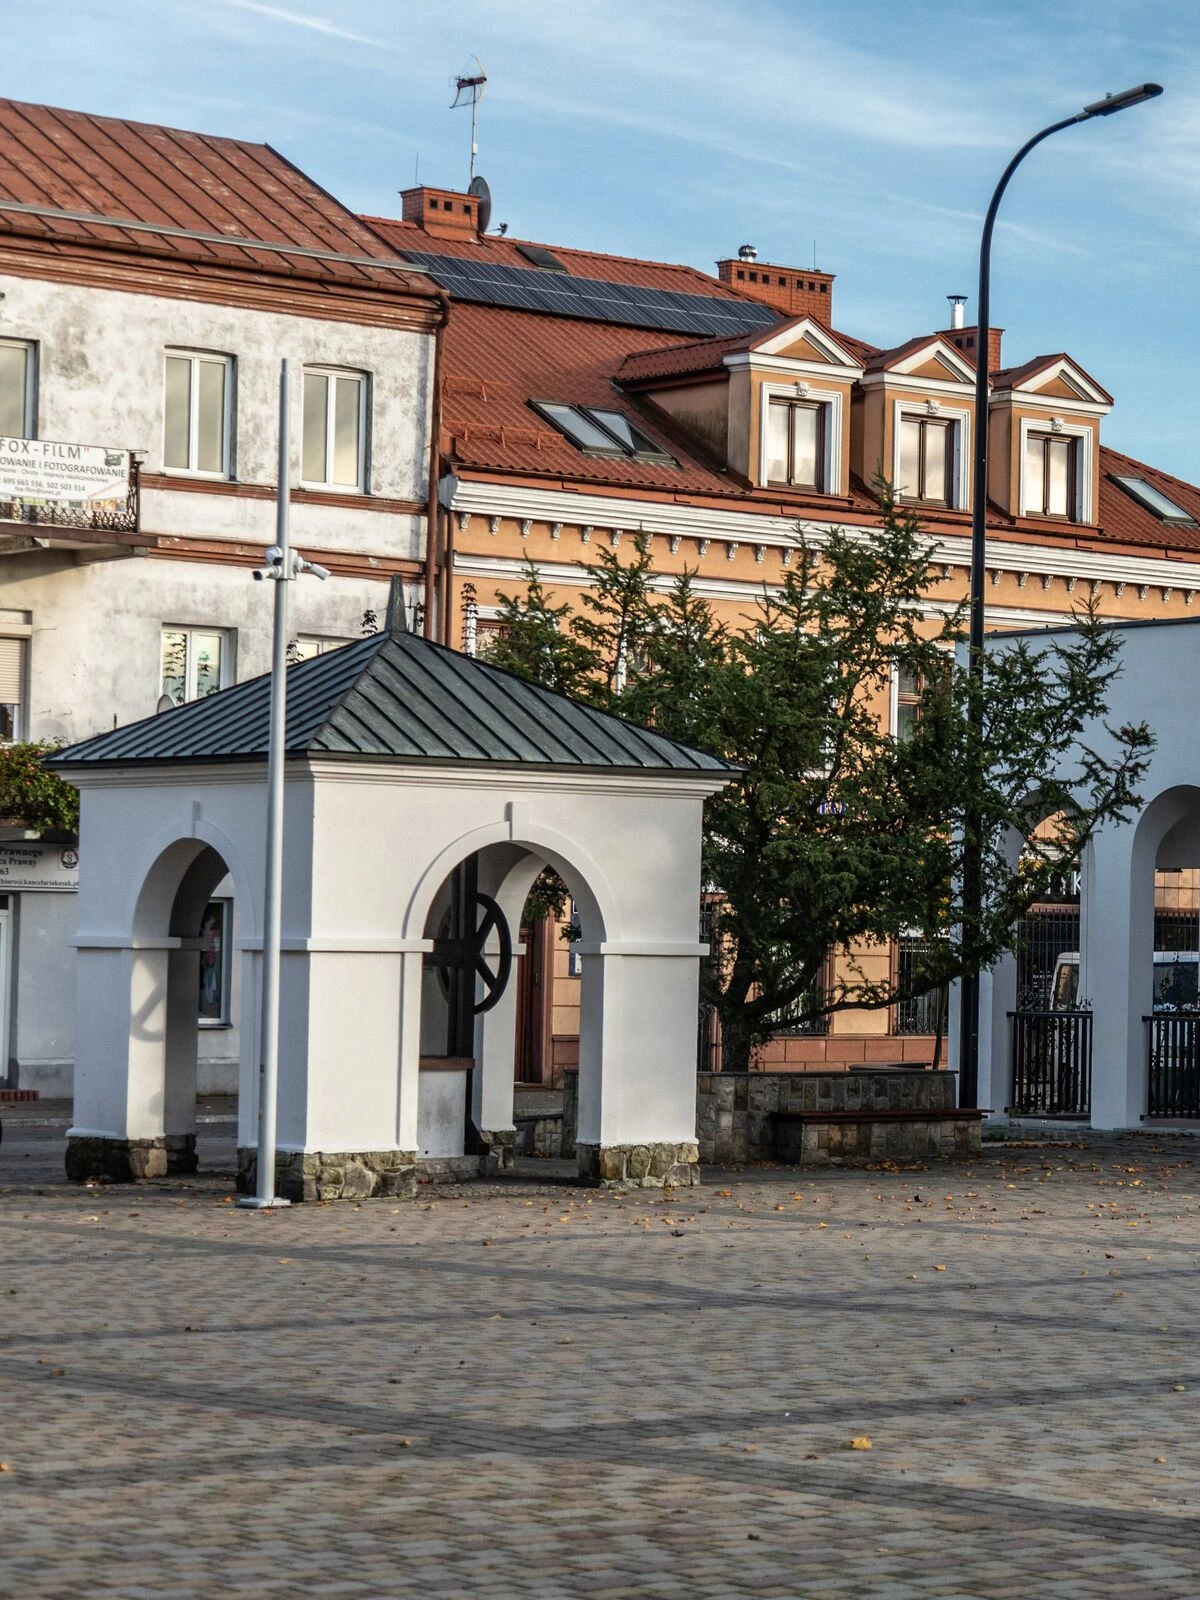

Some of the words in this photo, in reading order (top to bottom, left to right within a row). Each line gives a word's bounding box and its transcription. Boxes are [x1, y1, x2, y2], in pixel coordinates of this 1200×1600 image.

[0, 439, 30, 454] FOX
[44, 461, 126, 478] FOTOGRAFOWANIE
[0, 847, 43, 858] Prawnego
[9, 857, 37, 868] Prawny
